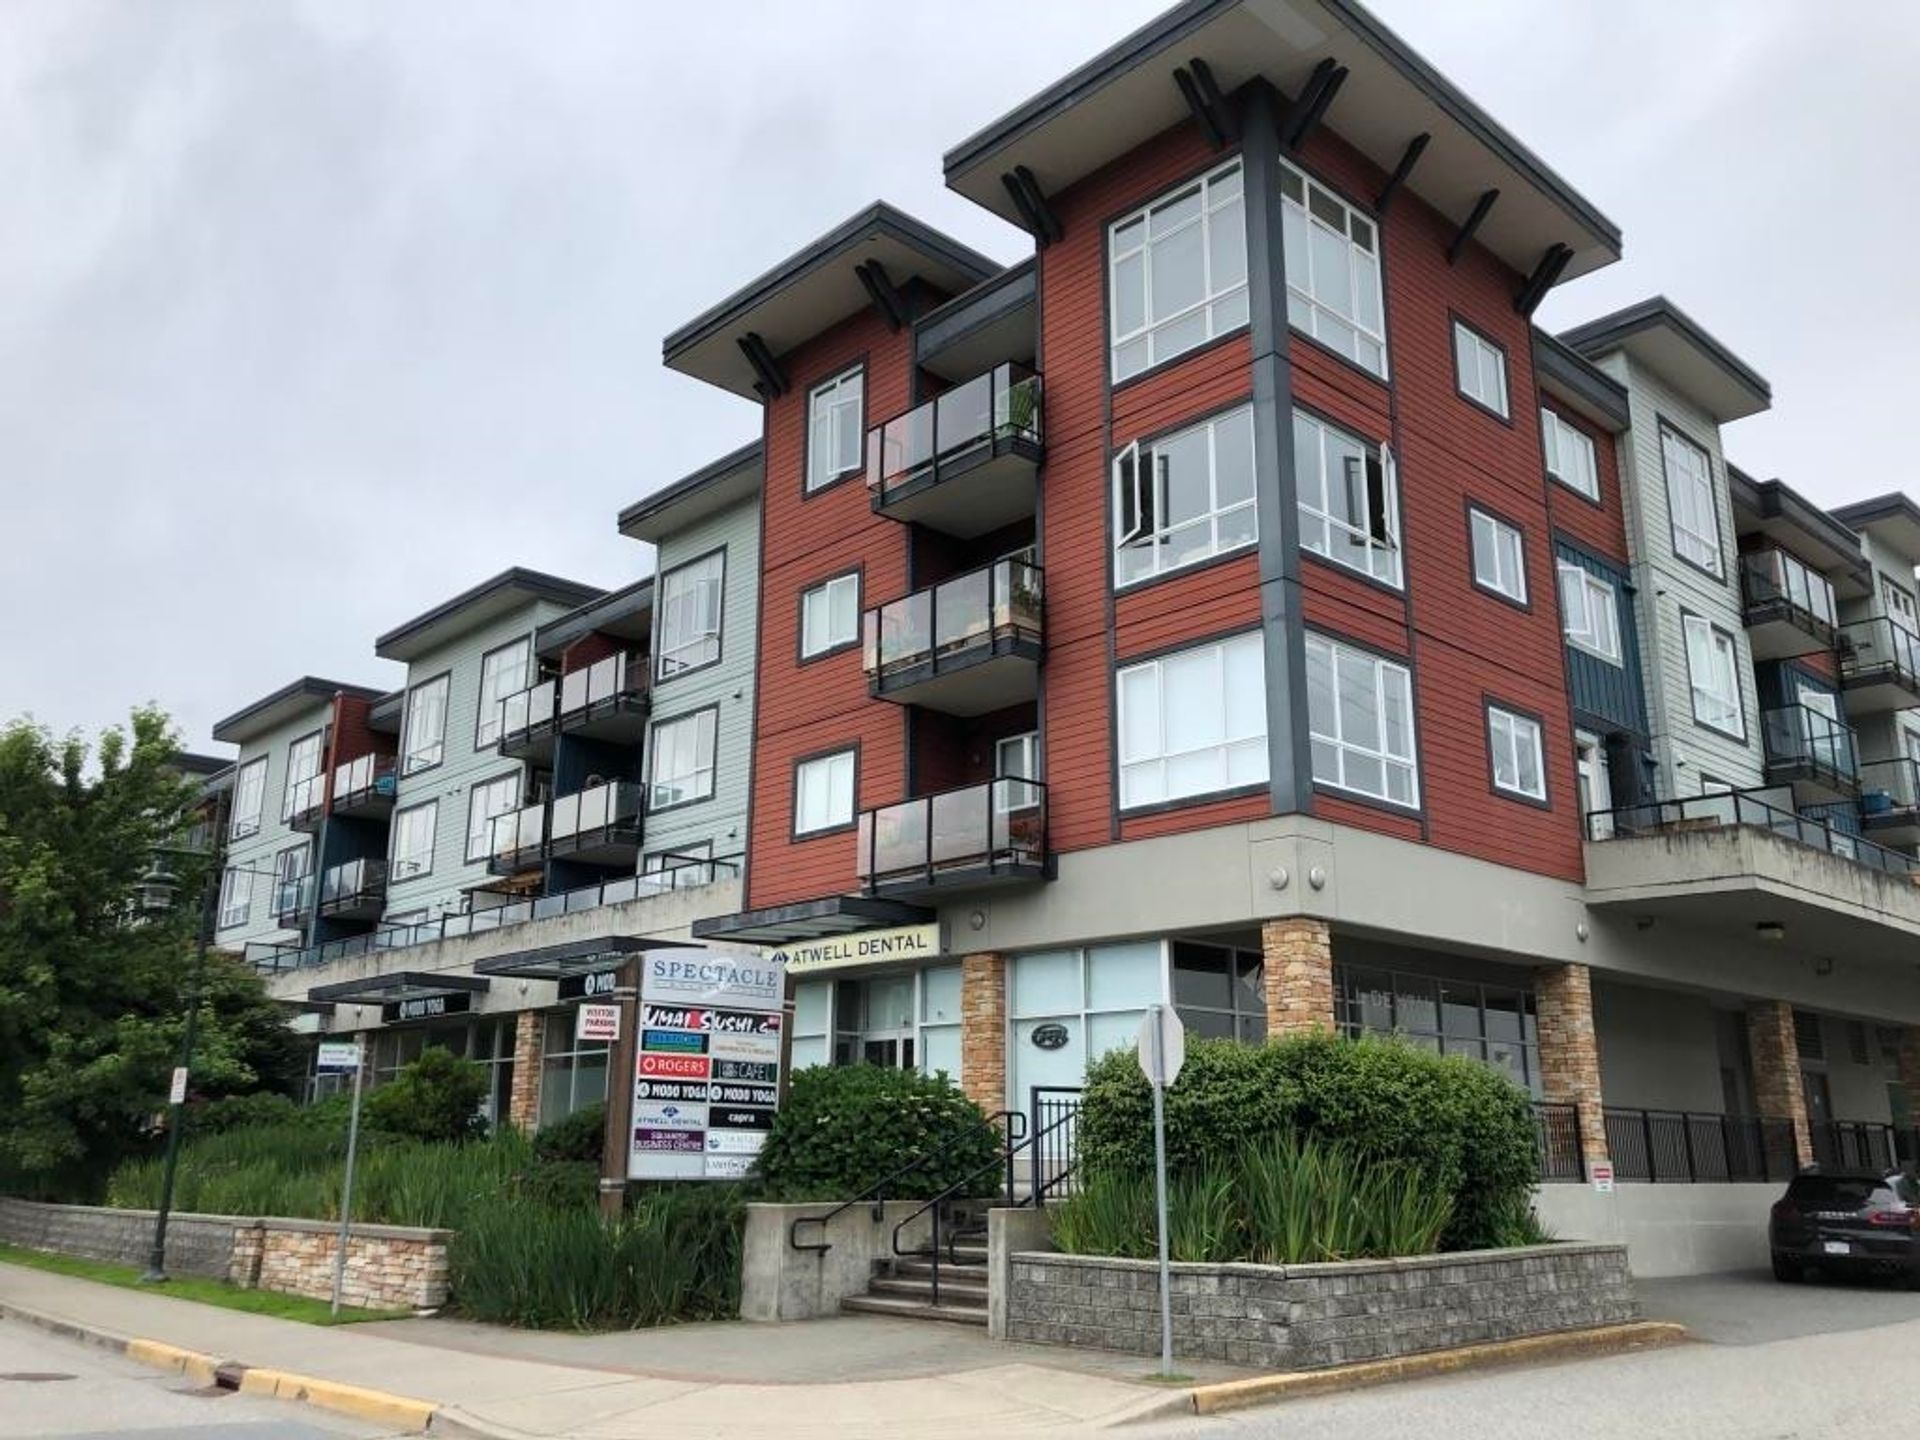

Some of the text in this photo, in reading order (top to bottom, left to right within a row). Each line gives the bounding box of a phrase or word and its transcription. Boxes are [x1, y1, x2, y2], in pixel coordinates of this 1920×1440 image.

[792, 933, 927, 965] ATWELL DENTAL
[653, 960, 778, 987] SPECTACLE
[657, 1059, 705, 1074] ROGERS
[682, 1084, 707, 1099] YOGA
[752, 1088, 776, 1103] YOGA
